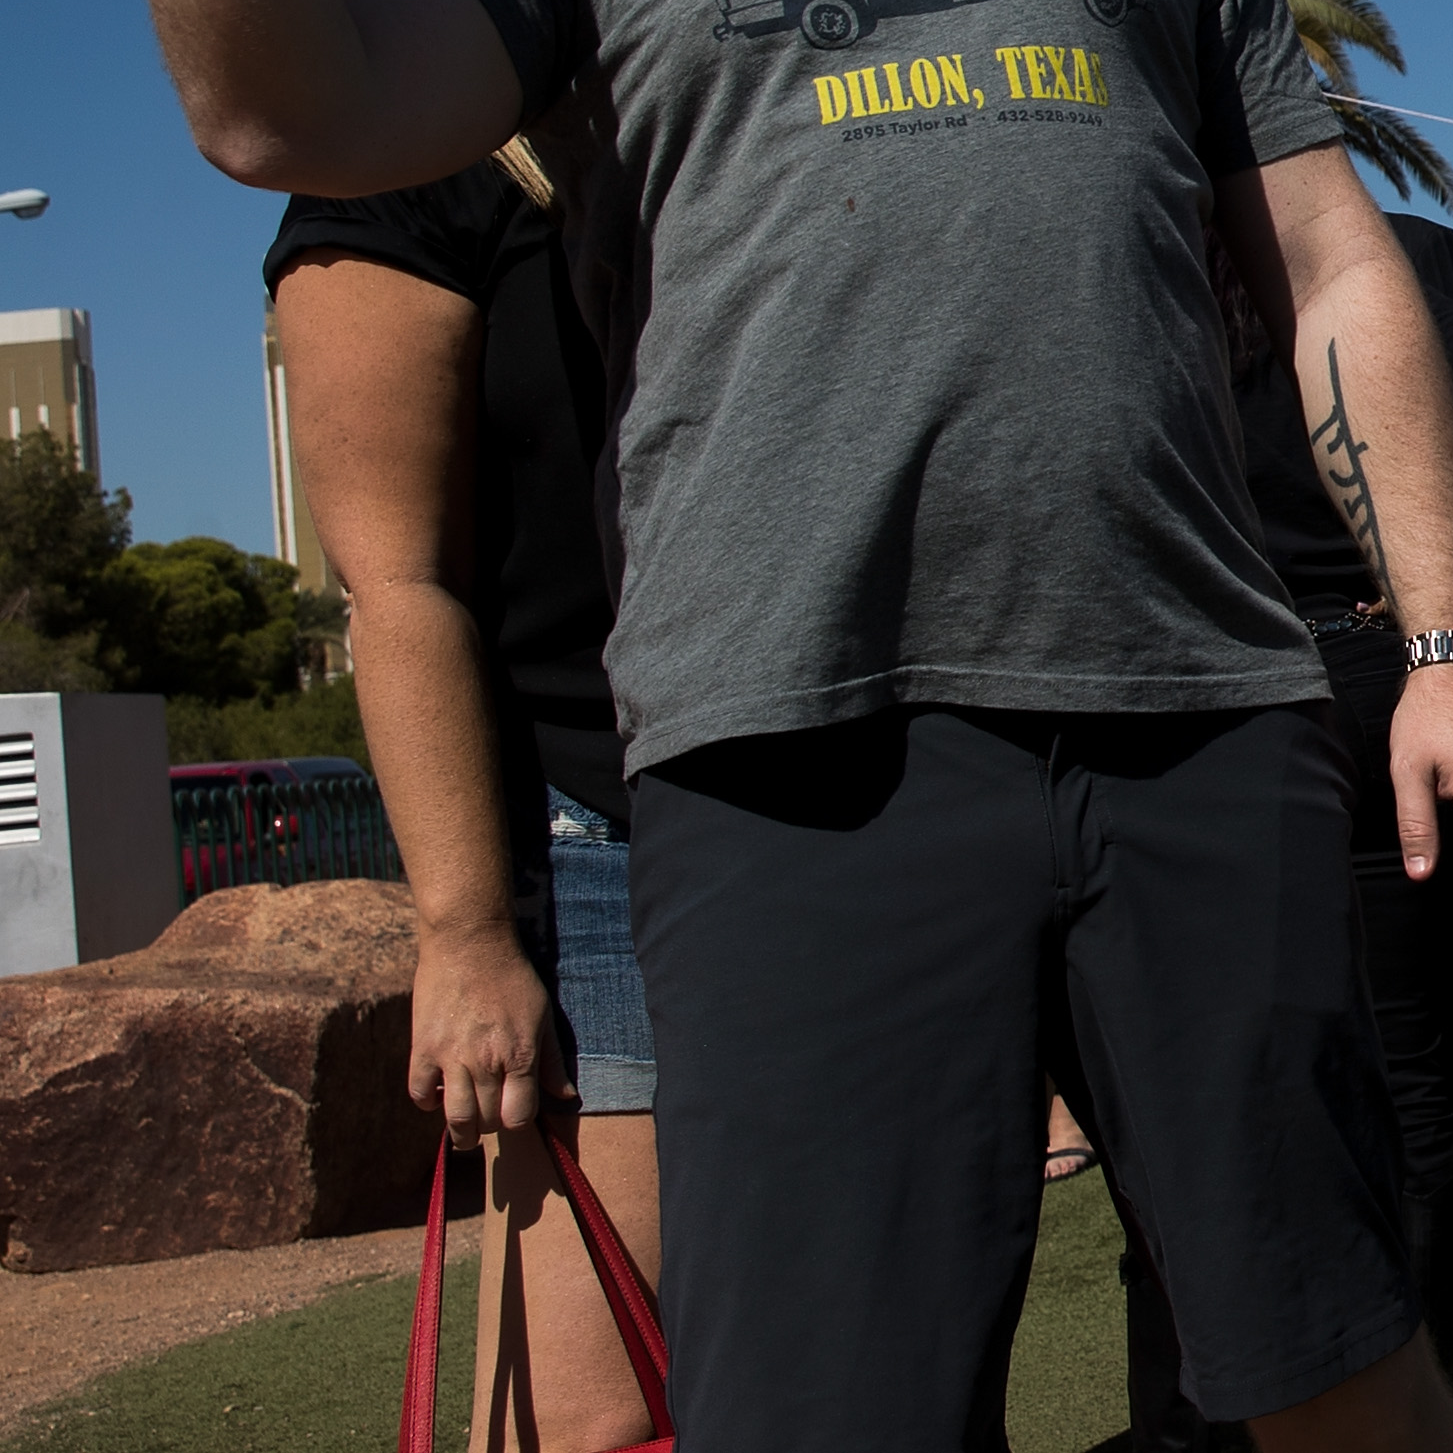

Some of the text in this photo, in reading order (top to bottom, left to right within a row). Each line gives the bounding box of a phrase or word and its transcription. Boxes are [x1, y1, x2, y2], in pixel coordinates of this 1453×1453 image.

[811, 55, 985, 126] DILLON,
[841, 110, 1103, 144] 2895 Taylor Rd 432-528-9249
